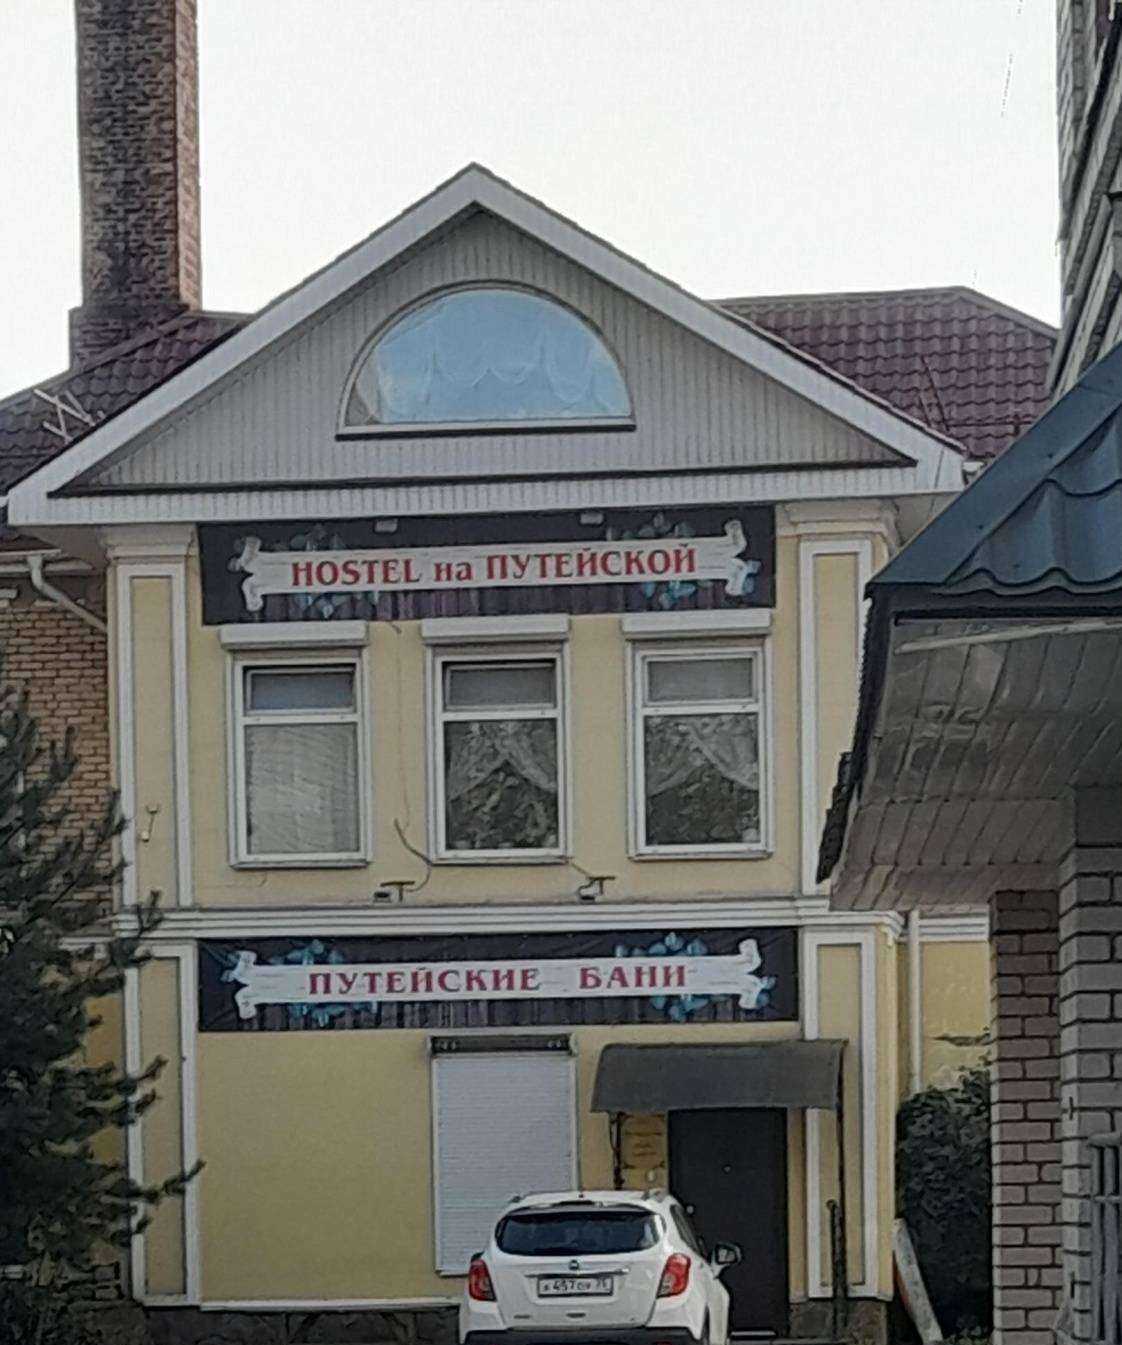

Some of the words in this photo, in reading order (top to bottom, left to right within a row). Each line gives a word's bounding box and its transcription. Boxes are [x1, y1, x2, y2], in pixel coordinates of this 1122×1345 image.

[291, 558, 423, 587] HOSTEL
[434, 561, 474, 583] на
[486, 543, 696, 580] ПУТЕЙСКОЙ
[308, 967, 542, 995] ПУТЕЙСКИЕ
[578, 965, 687, 990] БАНИ
